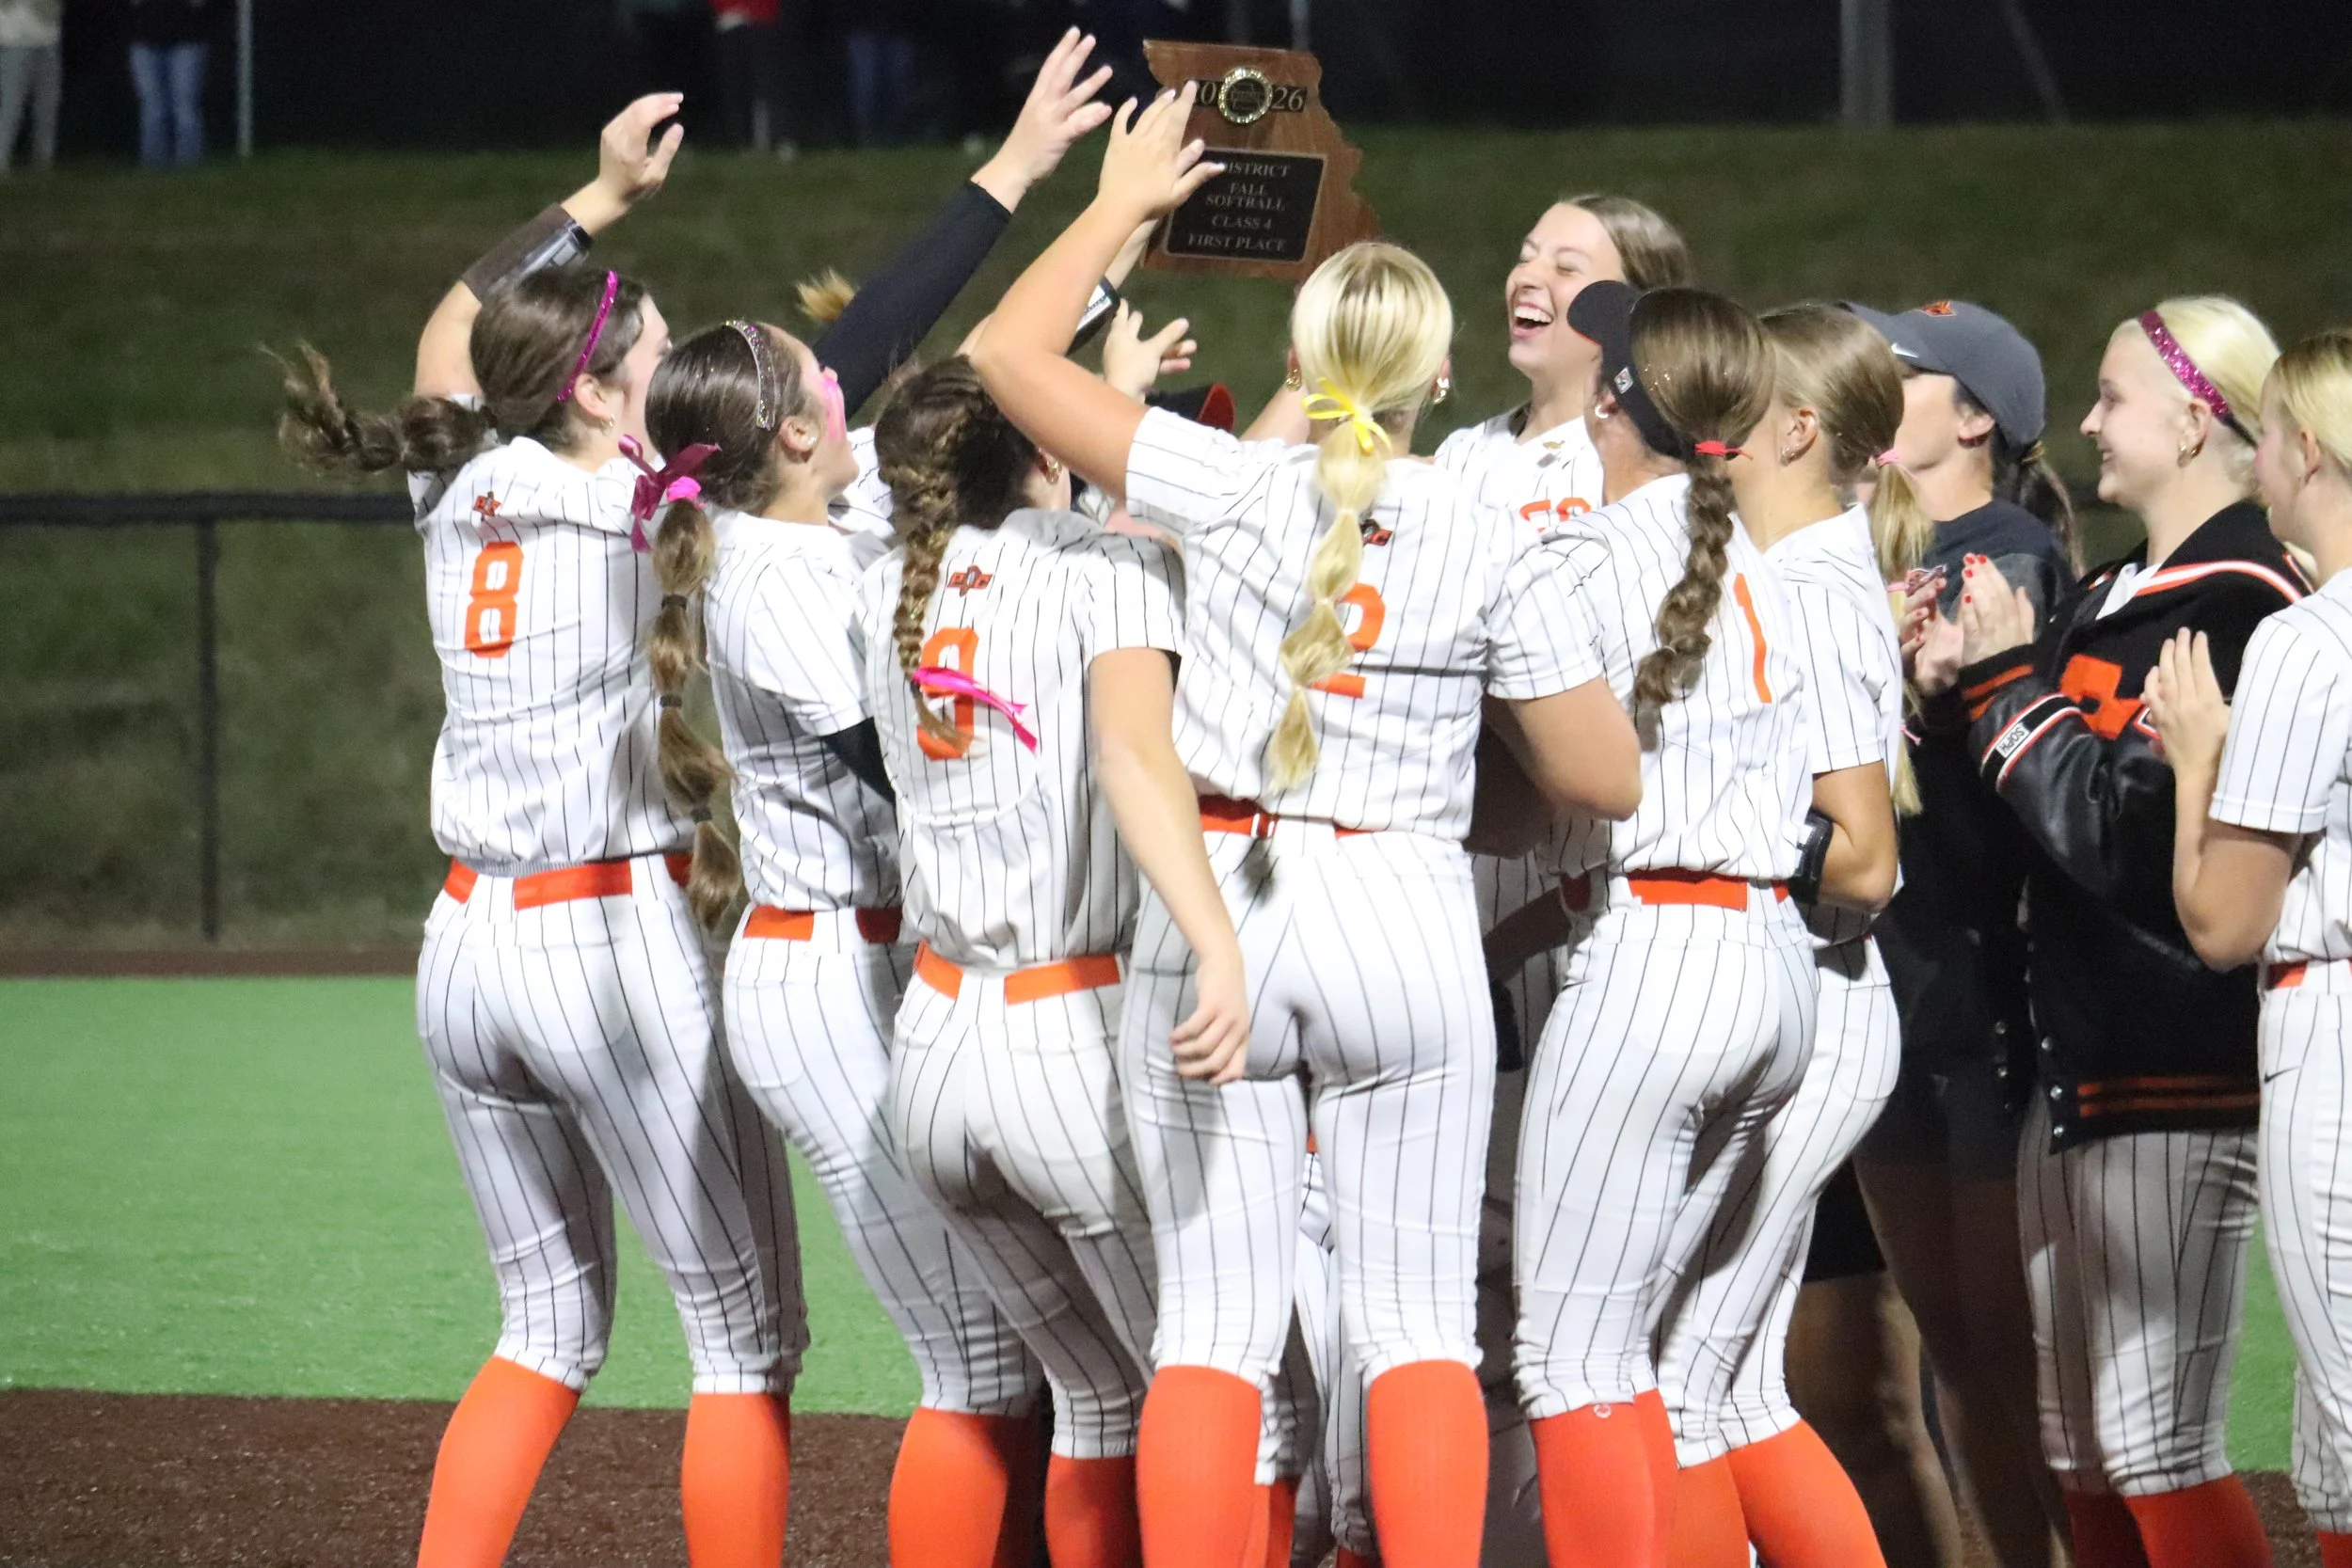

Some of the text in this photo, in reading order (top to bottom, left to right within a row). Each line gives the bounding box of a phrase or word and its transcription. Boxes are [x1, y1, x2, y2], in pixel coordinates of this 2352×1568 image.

[1271, 87, 1304, 111] 26
[1225, 162, 1290, 178] ISTRICT
[1230, 182, 1267, 195] FALL
[1205, 195, 1286, 211] SOFTBALL
[1211, 215, 1273, 230] CLASS 4
[1188, 233, 1287, 252] FIRST PLACE
[464, 541, 524, 658] 8
